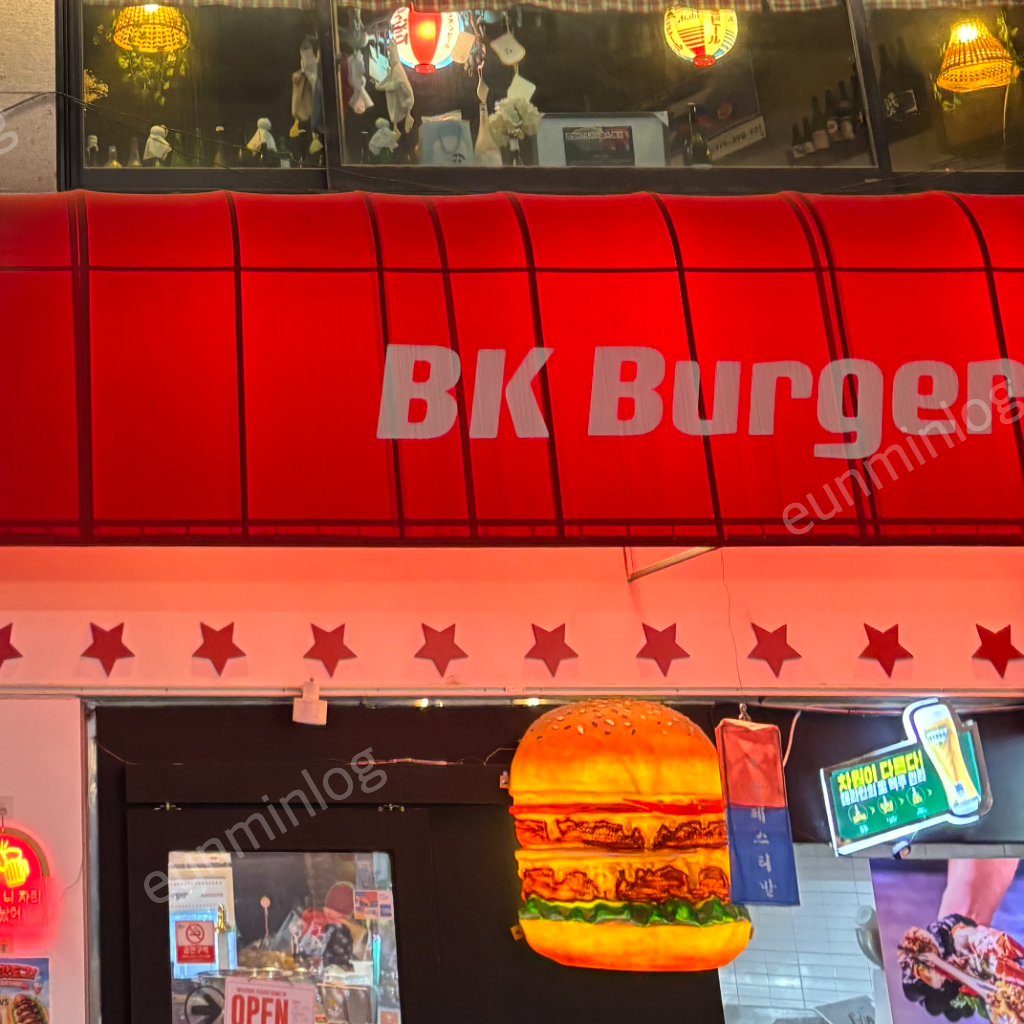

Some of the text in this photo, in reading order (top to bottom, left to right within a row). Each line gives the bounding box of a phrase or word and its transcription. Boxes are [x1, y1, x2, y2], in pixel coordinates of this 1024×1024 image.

[376, 343, 1024, 459] BK Burger
[231, 994, 288, 1024] OPEN
